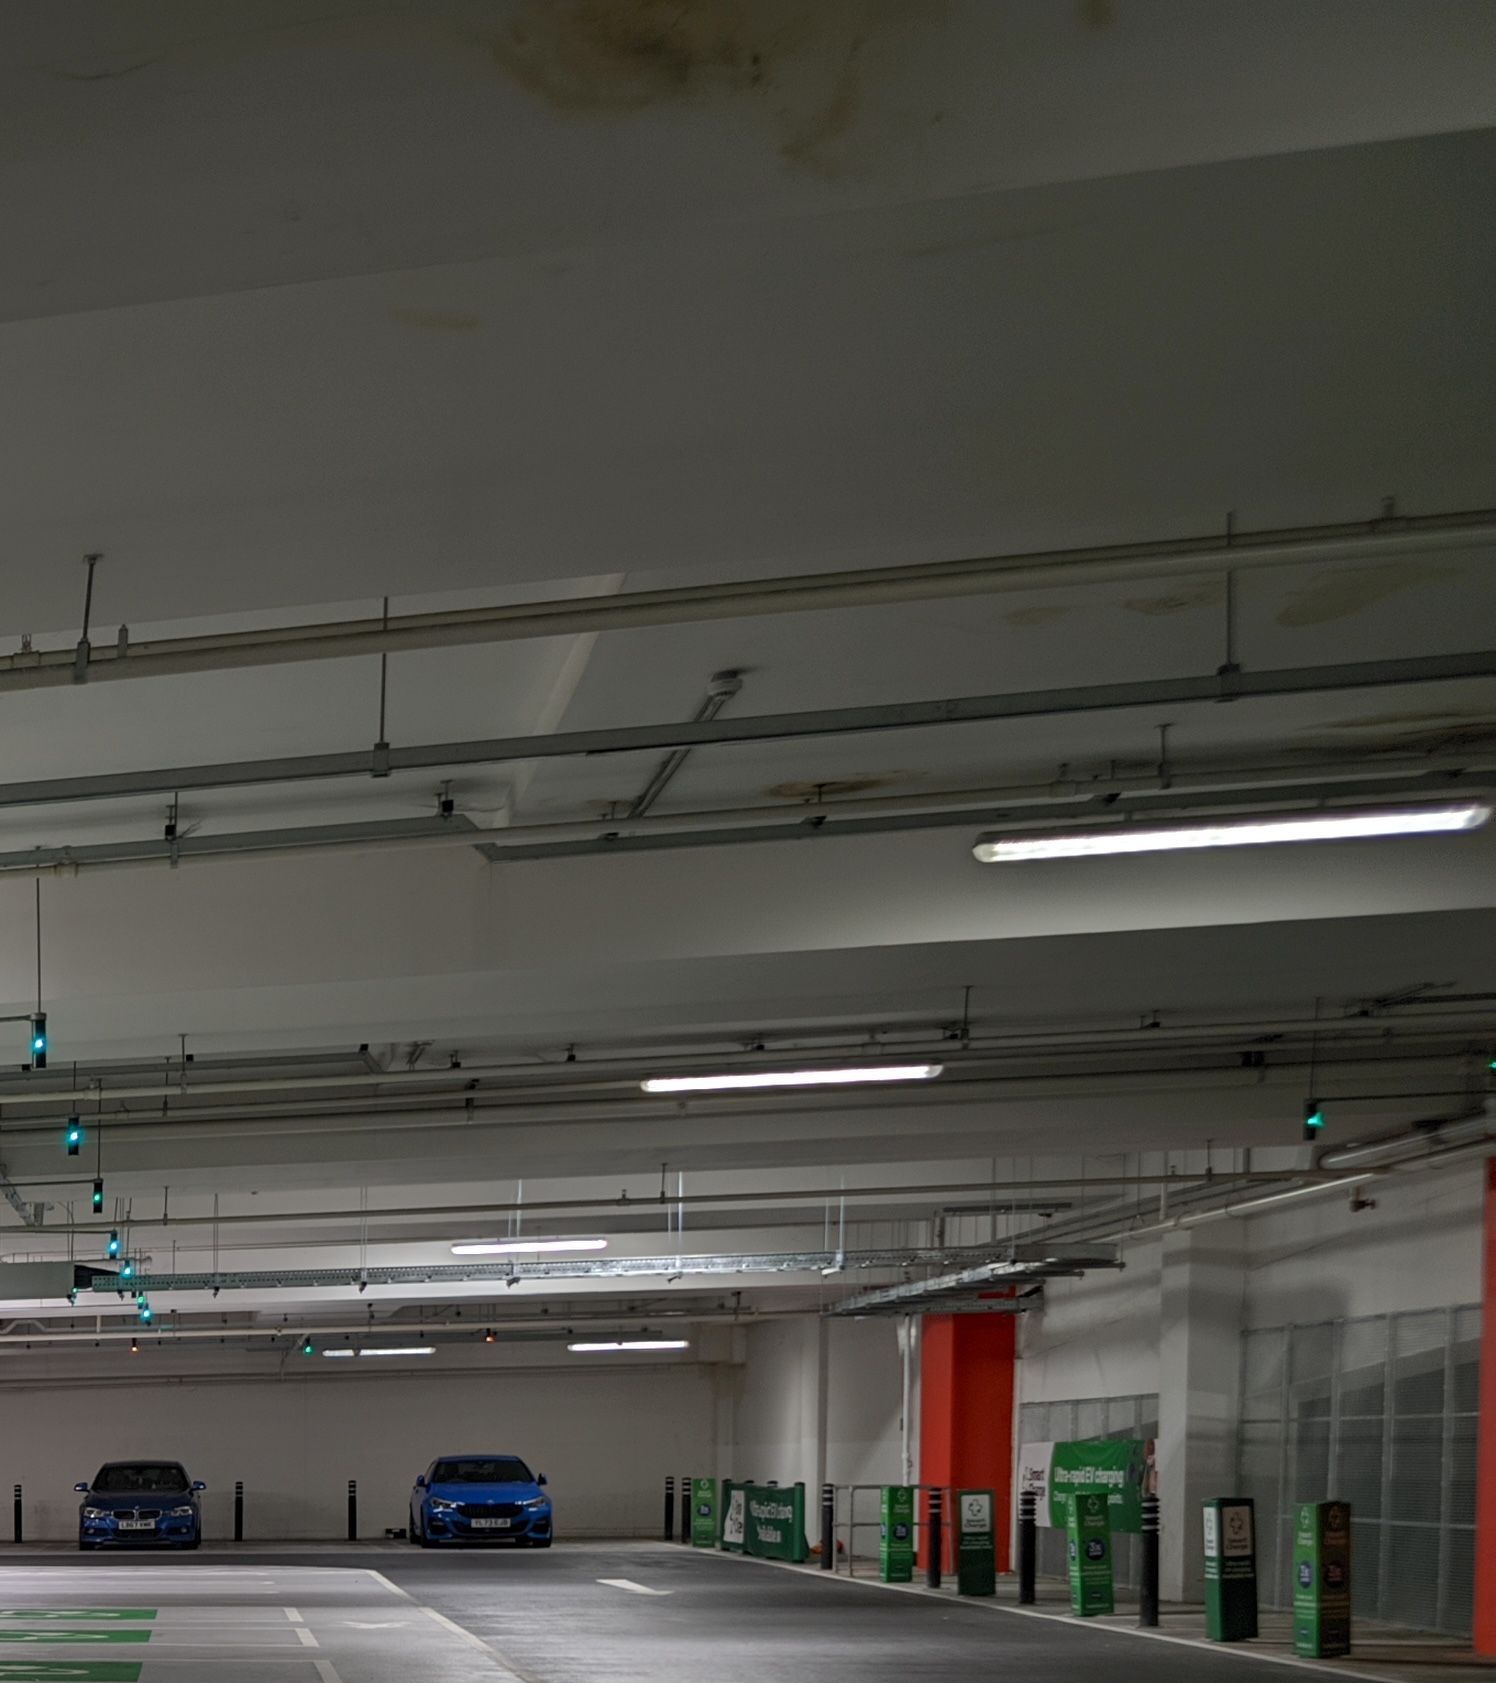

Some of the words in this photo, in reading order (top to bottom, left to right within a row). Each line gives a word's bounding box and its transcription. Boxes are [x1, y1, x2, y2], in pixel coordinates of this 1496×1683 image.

[1054, 1466, 1085, 1487] Ultra-rapid
[1085, 1467, 1095, 1484] EV
[1095, 1466, 1125, 1488] charging
